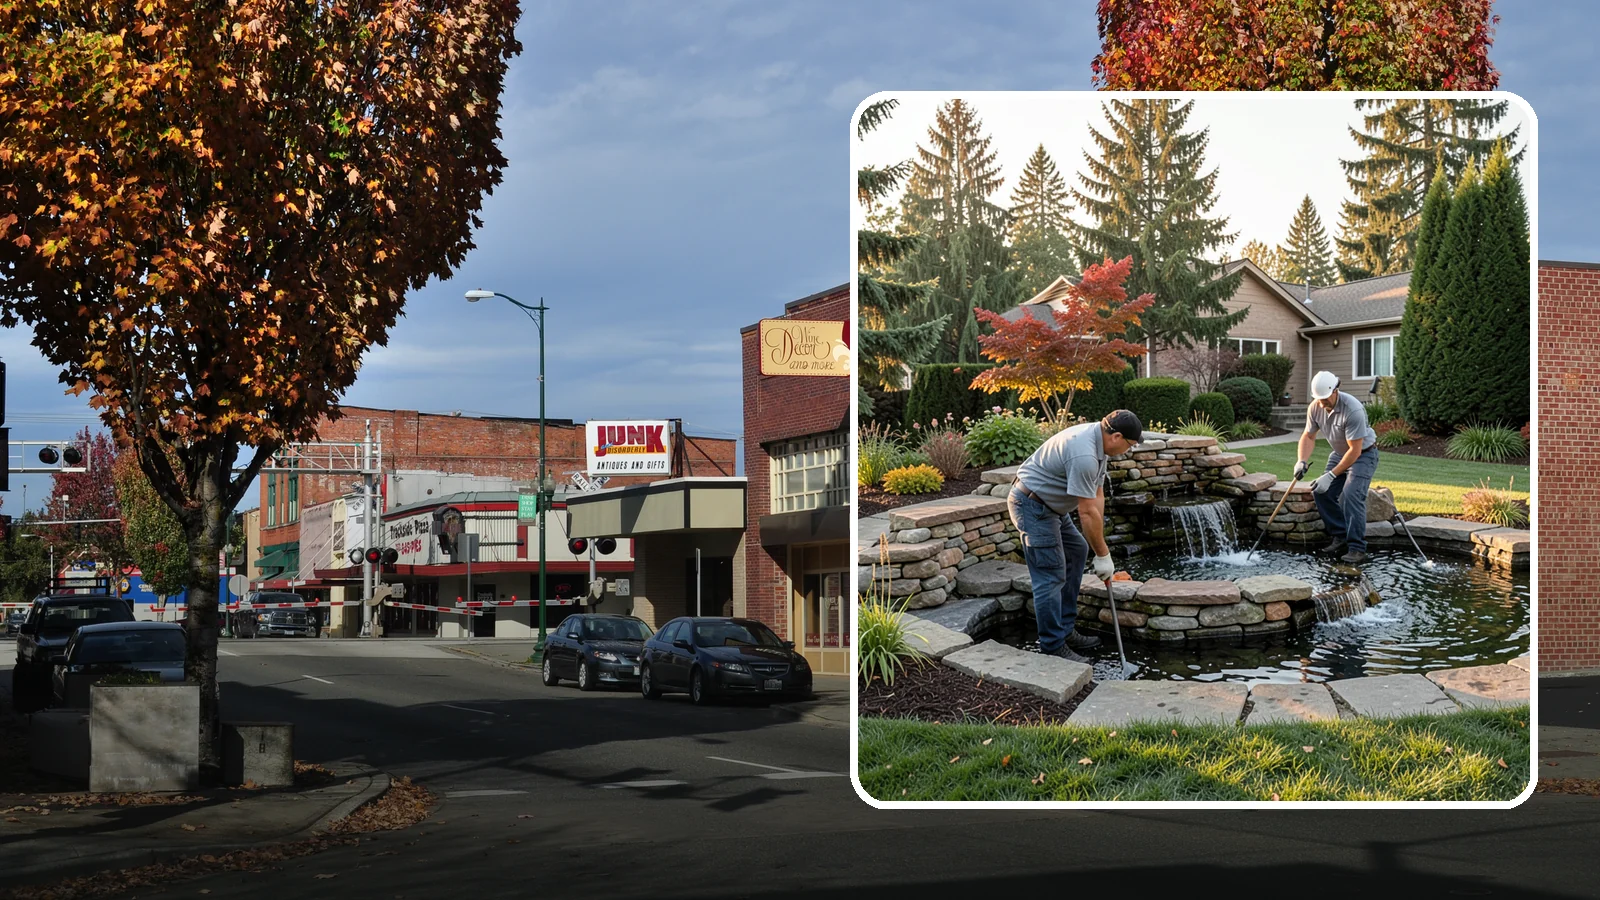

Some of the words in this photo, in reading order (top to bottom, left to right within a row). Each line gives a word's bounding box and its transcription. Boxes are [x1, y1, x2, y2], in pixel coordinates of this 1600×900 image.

[595, 425, 665, 457] JUNK
[607, 446, 646, 454] DISORDERLY
[597, 461, 628, 470] ANTIQUES
[631, 461, 644, 470] AND
[647, 460, 665, 469] GIFTS
[573, 473, 589, 492] RAIL
[352, 498, 365, 511] CRO
[414, 519, 429, 535] Pizza
